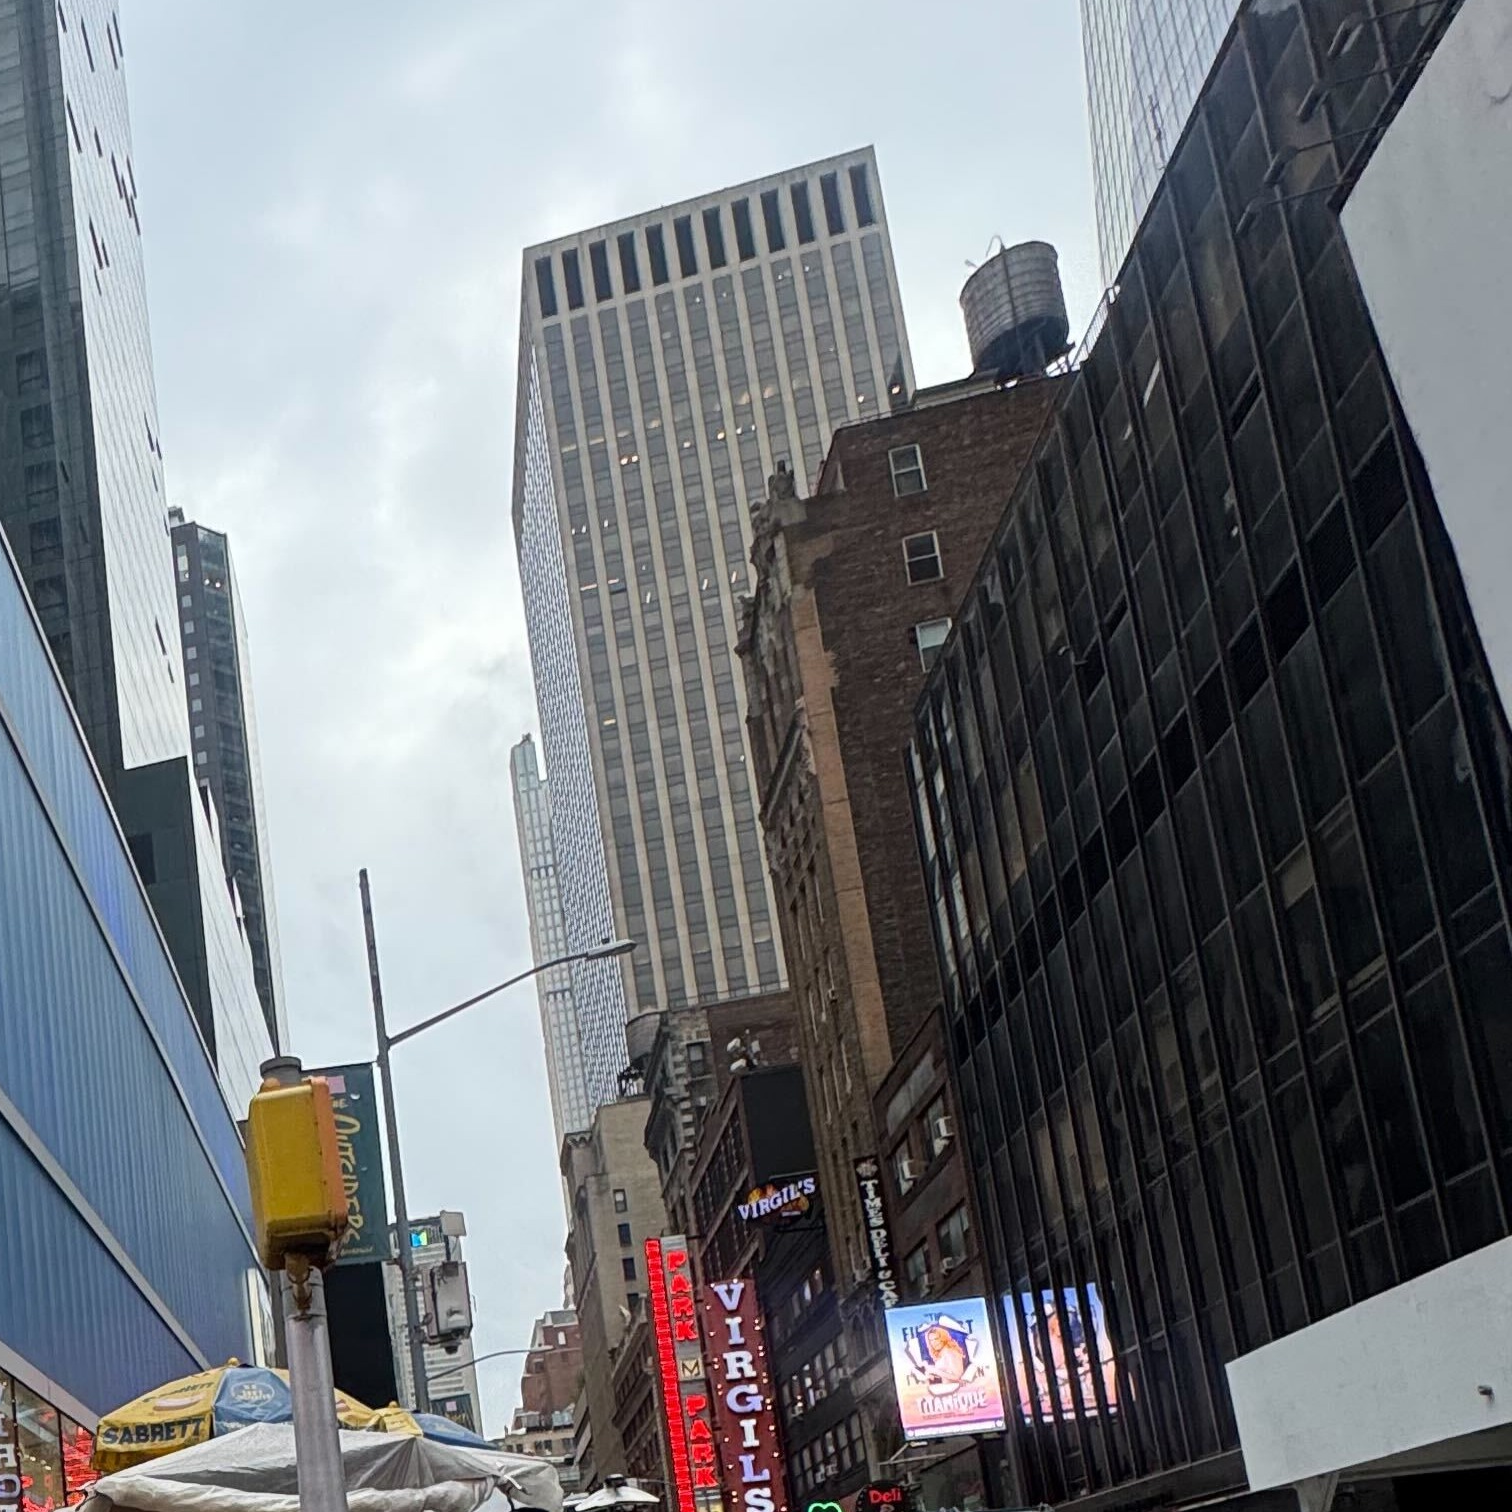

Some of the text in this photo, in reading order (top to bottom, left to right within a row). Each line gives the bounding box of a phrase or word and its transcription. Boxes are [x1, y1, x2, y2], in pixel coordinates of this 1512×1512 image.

[738, 1176, 816, 1221] VIRGIL'S
[860, 1180, 885, 1228] TIMES
[870, 1229, 890, 1268] DELI
[666, 1251, 699, 1341] PARK
[102, 1418, 204, 1445] SABRETT
[685, 1394, 719, 1488] PARK
[868, 1488, 902, 1504] Deli
